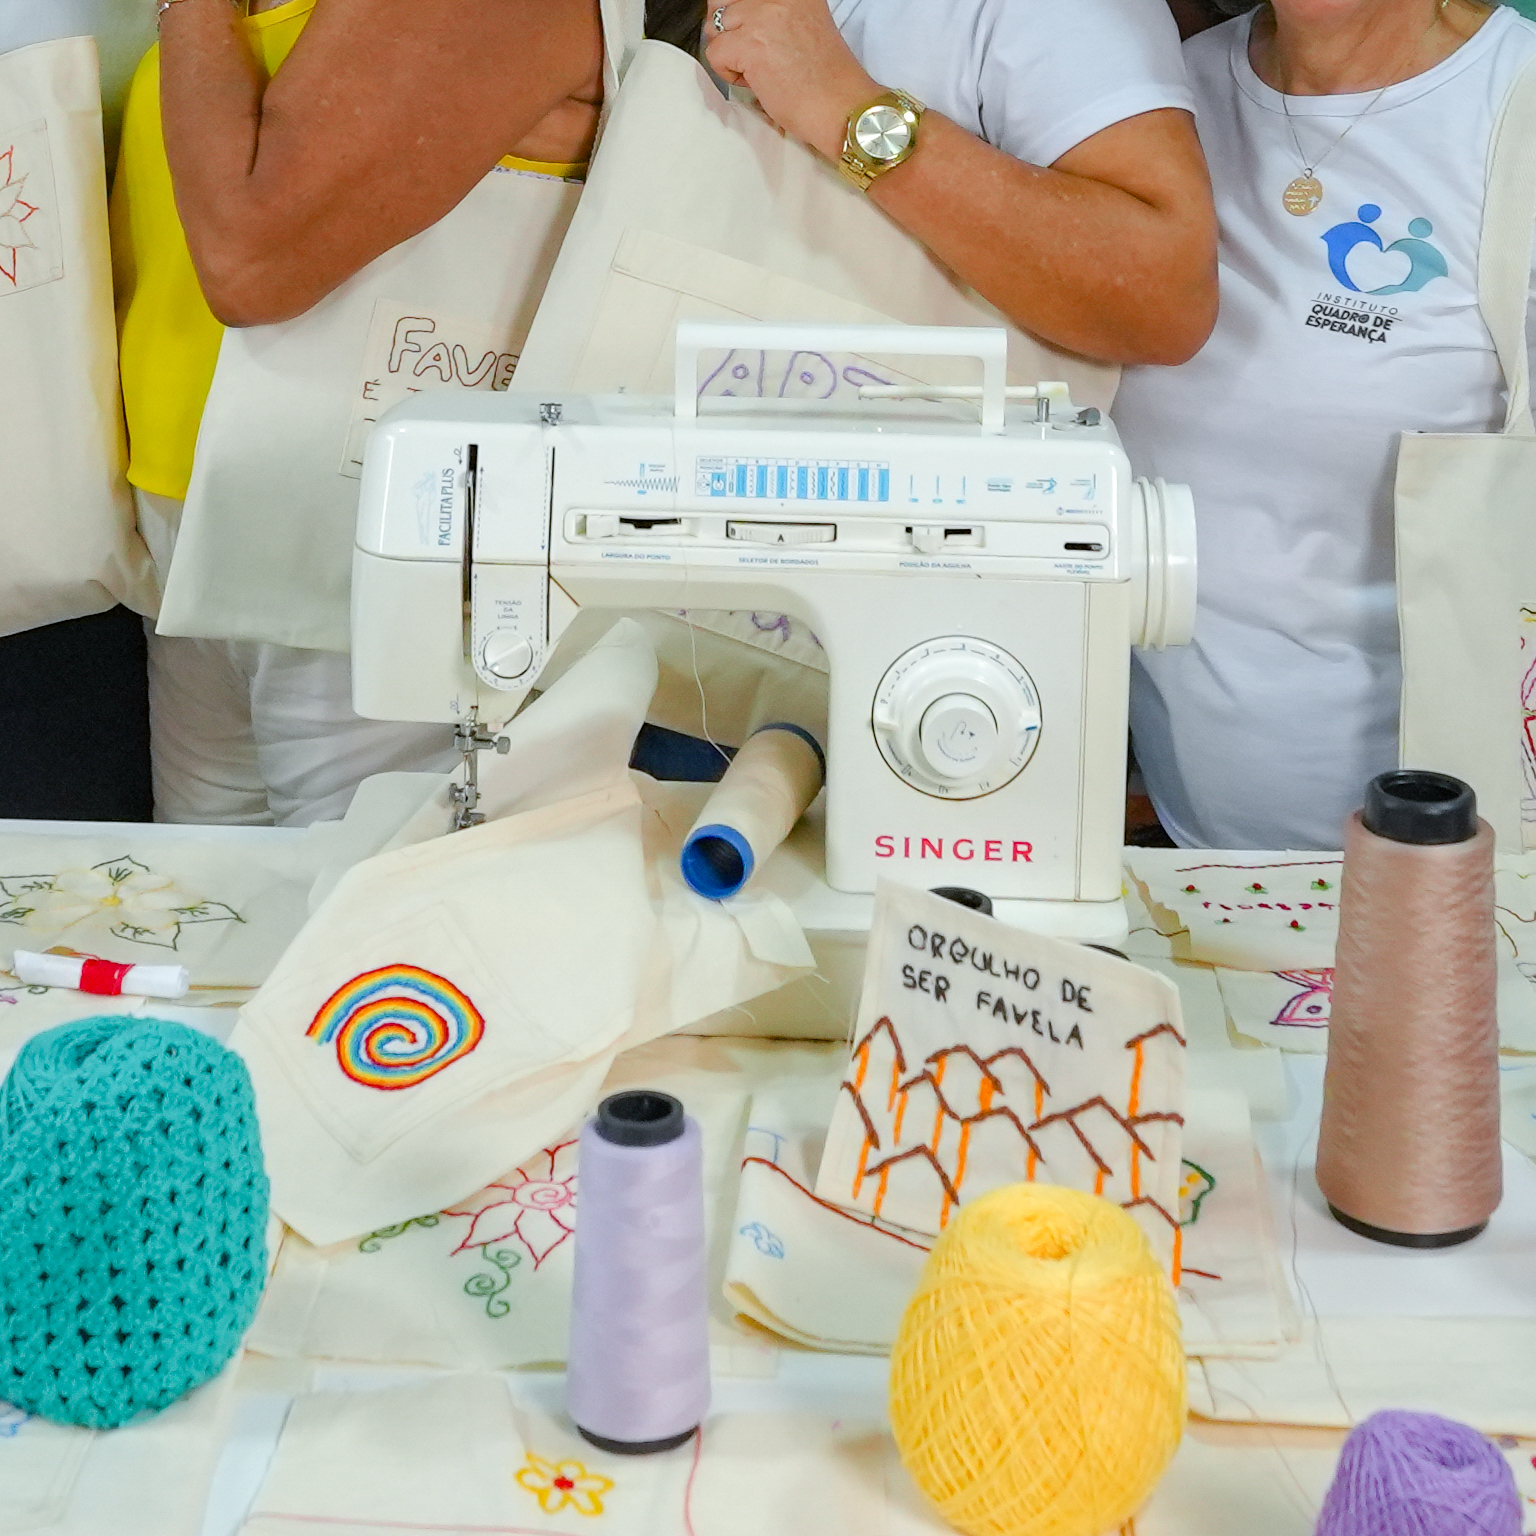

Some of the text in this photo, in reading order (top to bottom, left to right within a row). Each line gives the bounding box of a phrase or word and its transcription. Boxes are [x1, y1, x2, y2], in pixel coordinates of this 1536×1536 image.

[1311, 303, 1394, 331] QUADRO DE
[1316, 292, 1399, 316] INSTITUTO
[1305, 316, 1387, 344] ESPERANÇA
[438, 467, 455, 546] FACILITA PLUS
[777, 534, 785, 543] A
[874, 835, 1034, 863] SINGER
[908, 924, 1094, 1013] ORGULHO DE
[901, 963, 1085, 1051] SER FAVELA
